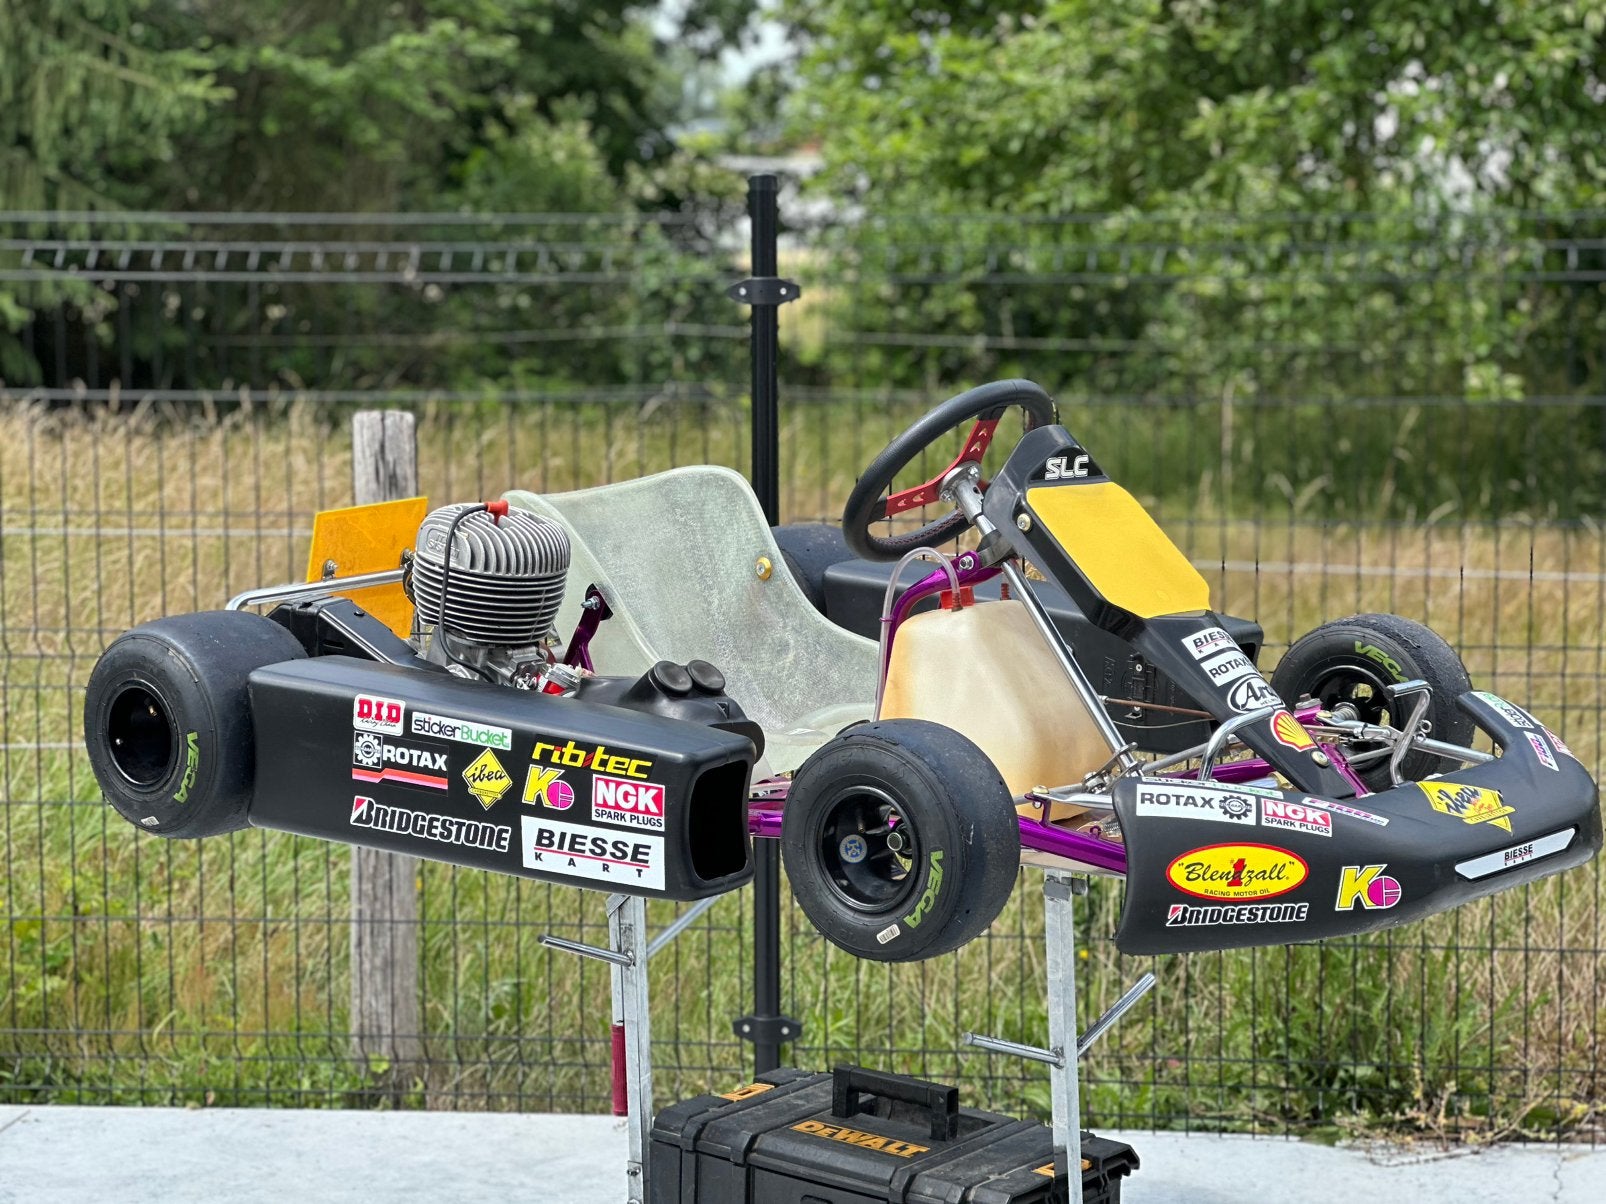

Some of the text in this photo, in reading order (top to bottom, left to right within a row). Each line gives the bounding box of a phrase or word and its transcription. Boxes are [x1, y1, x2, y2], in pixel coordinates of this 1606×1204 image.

[1045, 455, 1089, 480] SLC
[357, 698, 401, 723] DID
[173, 731, 199, 803] VEGA
[382, 744, 447, 771] ROTAX
[468, 763, 506, 782] ibea
[596, 779, 659, 813] NGK
[1140, 792, 1215, 809] ROTAX
[351, 796, 511, 852] BRIDGESTONE
[594, 808, 663, 828] SPARK PLUGS
[1264, 801, 1328, 825] NGK
[1264, 816, 1330, 835] SPARK PLUGS
[535, 827, 652, 864] BIESSE
[1505, 844, 1533, 860] BIESSE
[903, 850, 944, 929] VEGA
[1204, 888, 1231, 897] RACING
[1166, 903, 1309, 927] BRIDGESTONE
[790, 1120, 930, 1158] DEWALT
